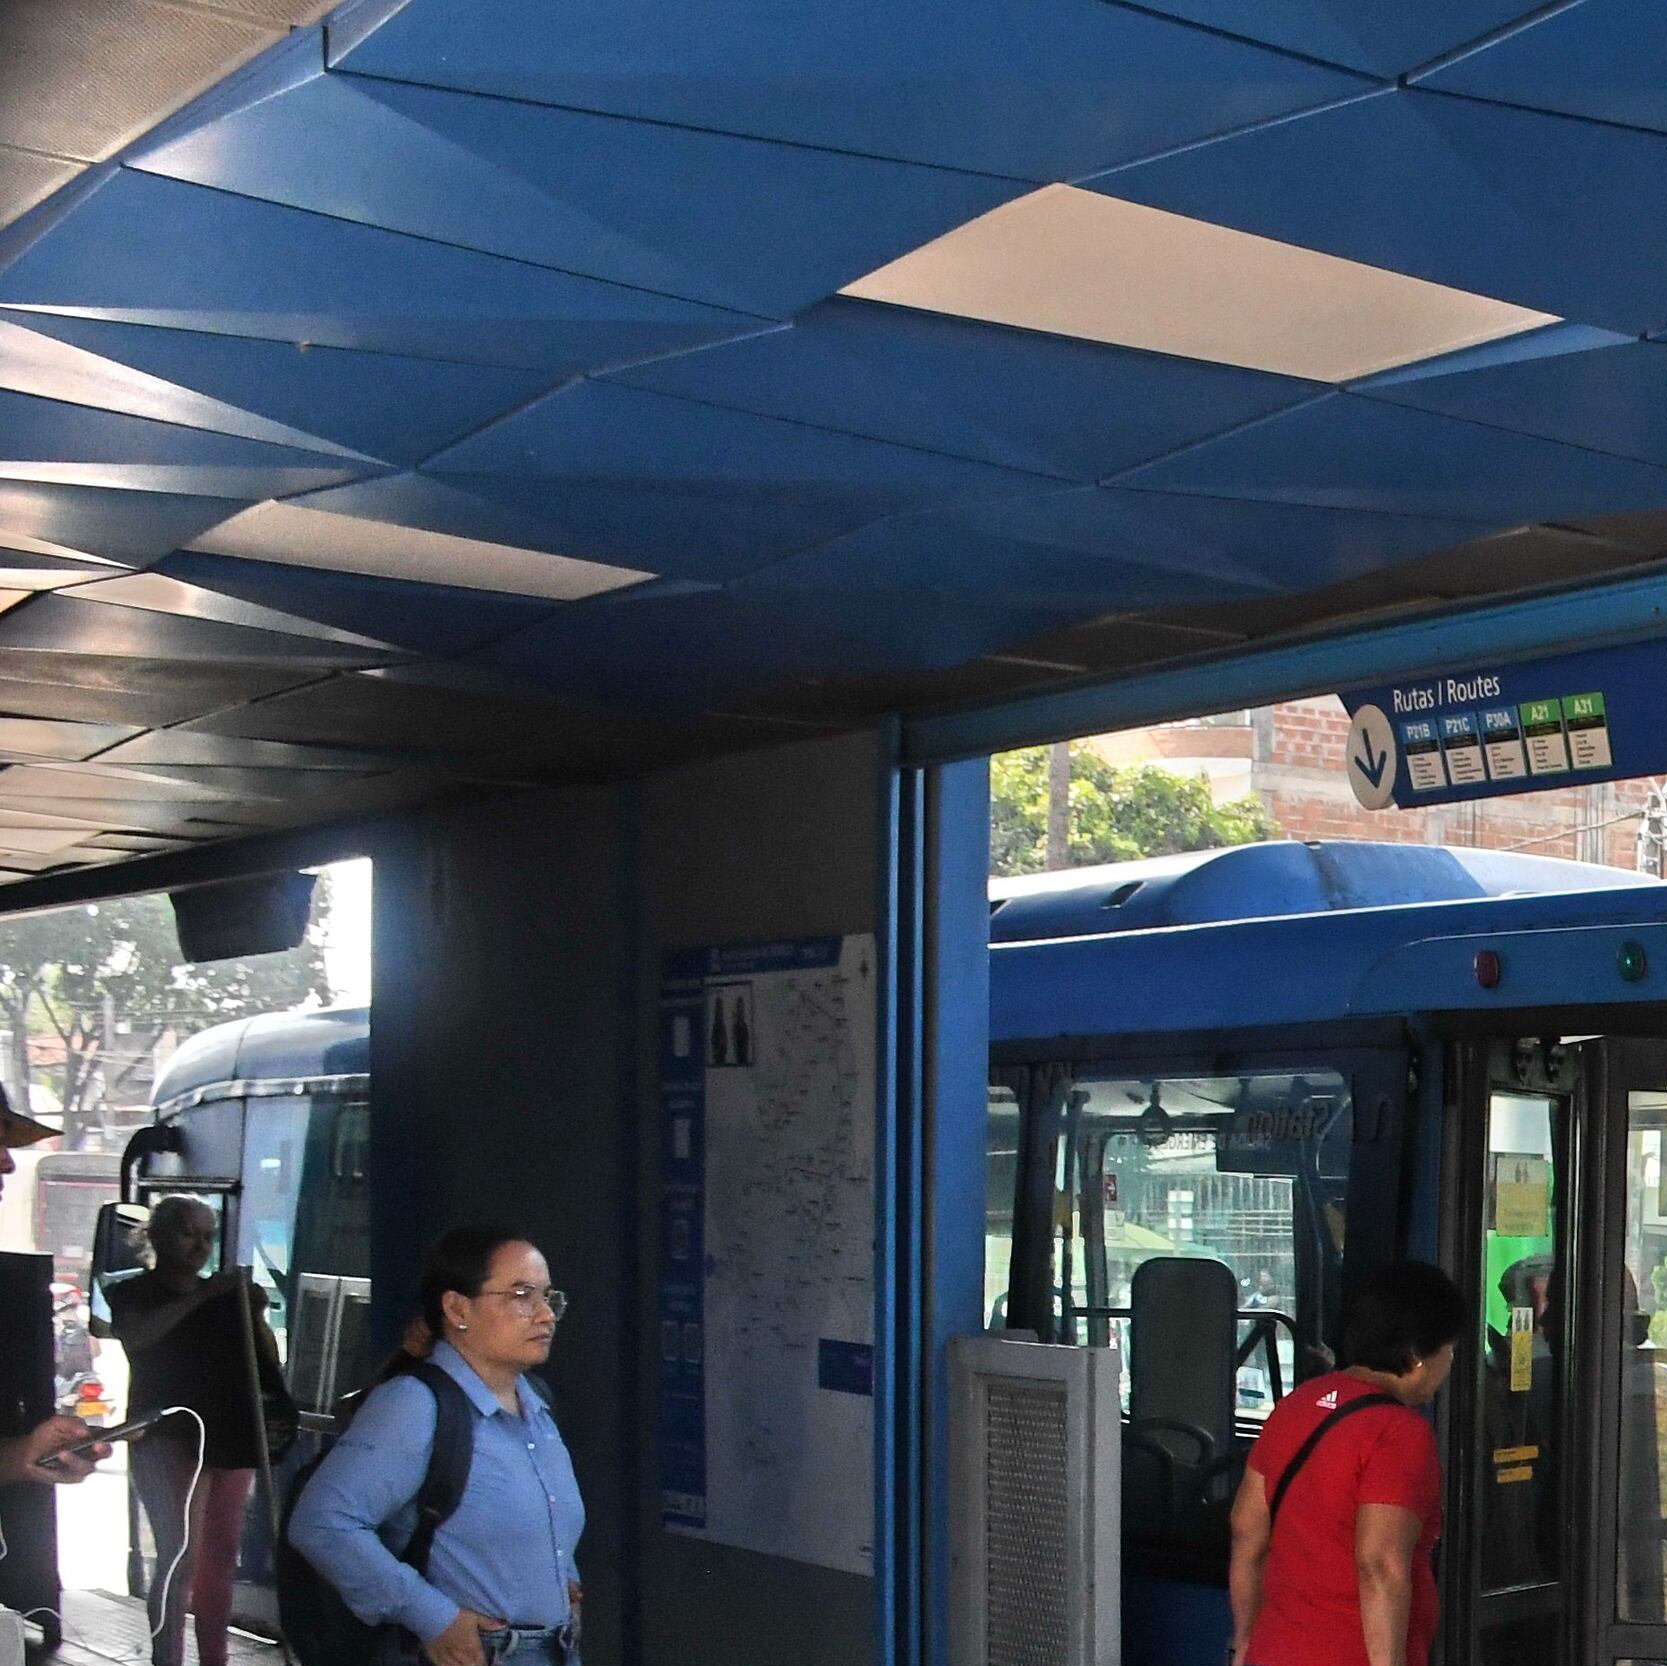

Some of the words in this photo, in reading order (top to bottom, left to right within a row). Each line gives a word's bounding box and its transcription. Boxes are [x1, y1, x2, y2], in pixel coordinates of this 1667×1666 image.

[1393, 688, 1435, 713] Rutas
[1438, 681, 1443, 706] /
[1447, 676, 1501, 704] Routes
[1531, 705, 1550, 721] A21
[1574, 698, 1593, 714] A31
[1445, 717, 1469, 734] P21C
[1485, 711, 1512, 729] P30A
[1406, 722, 1431, 739] P21B
